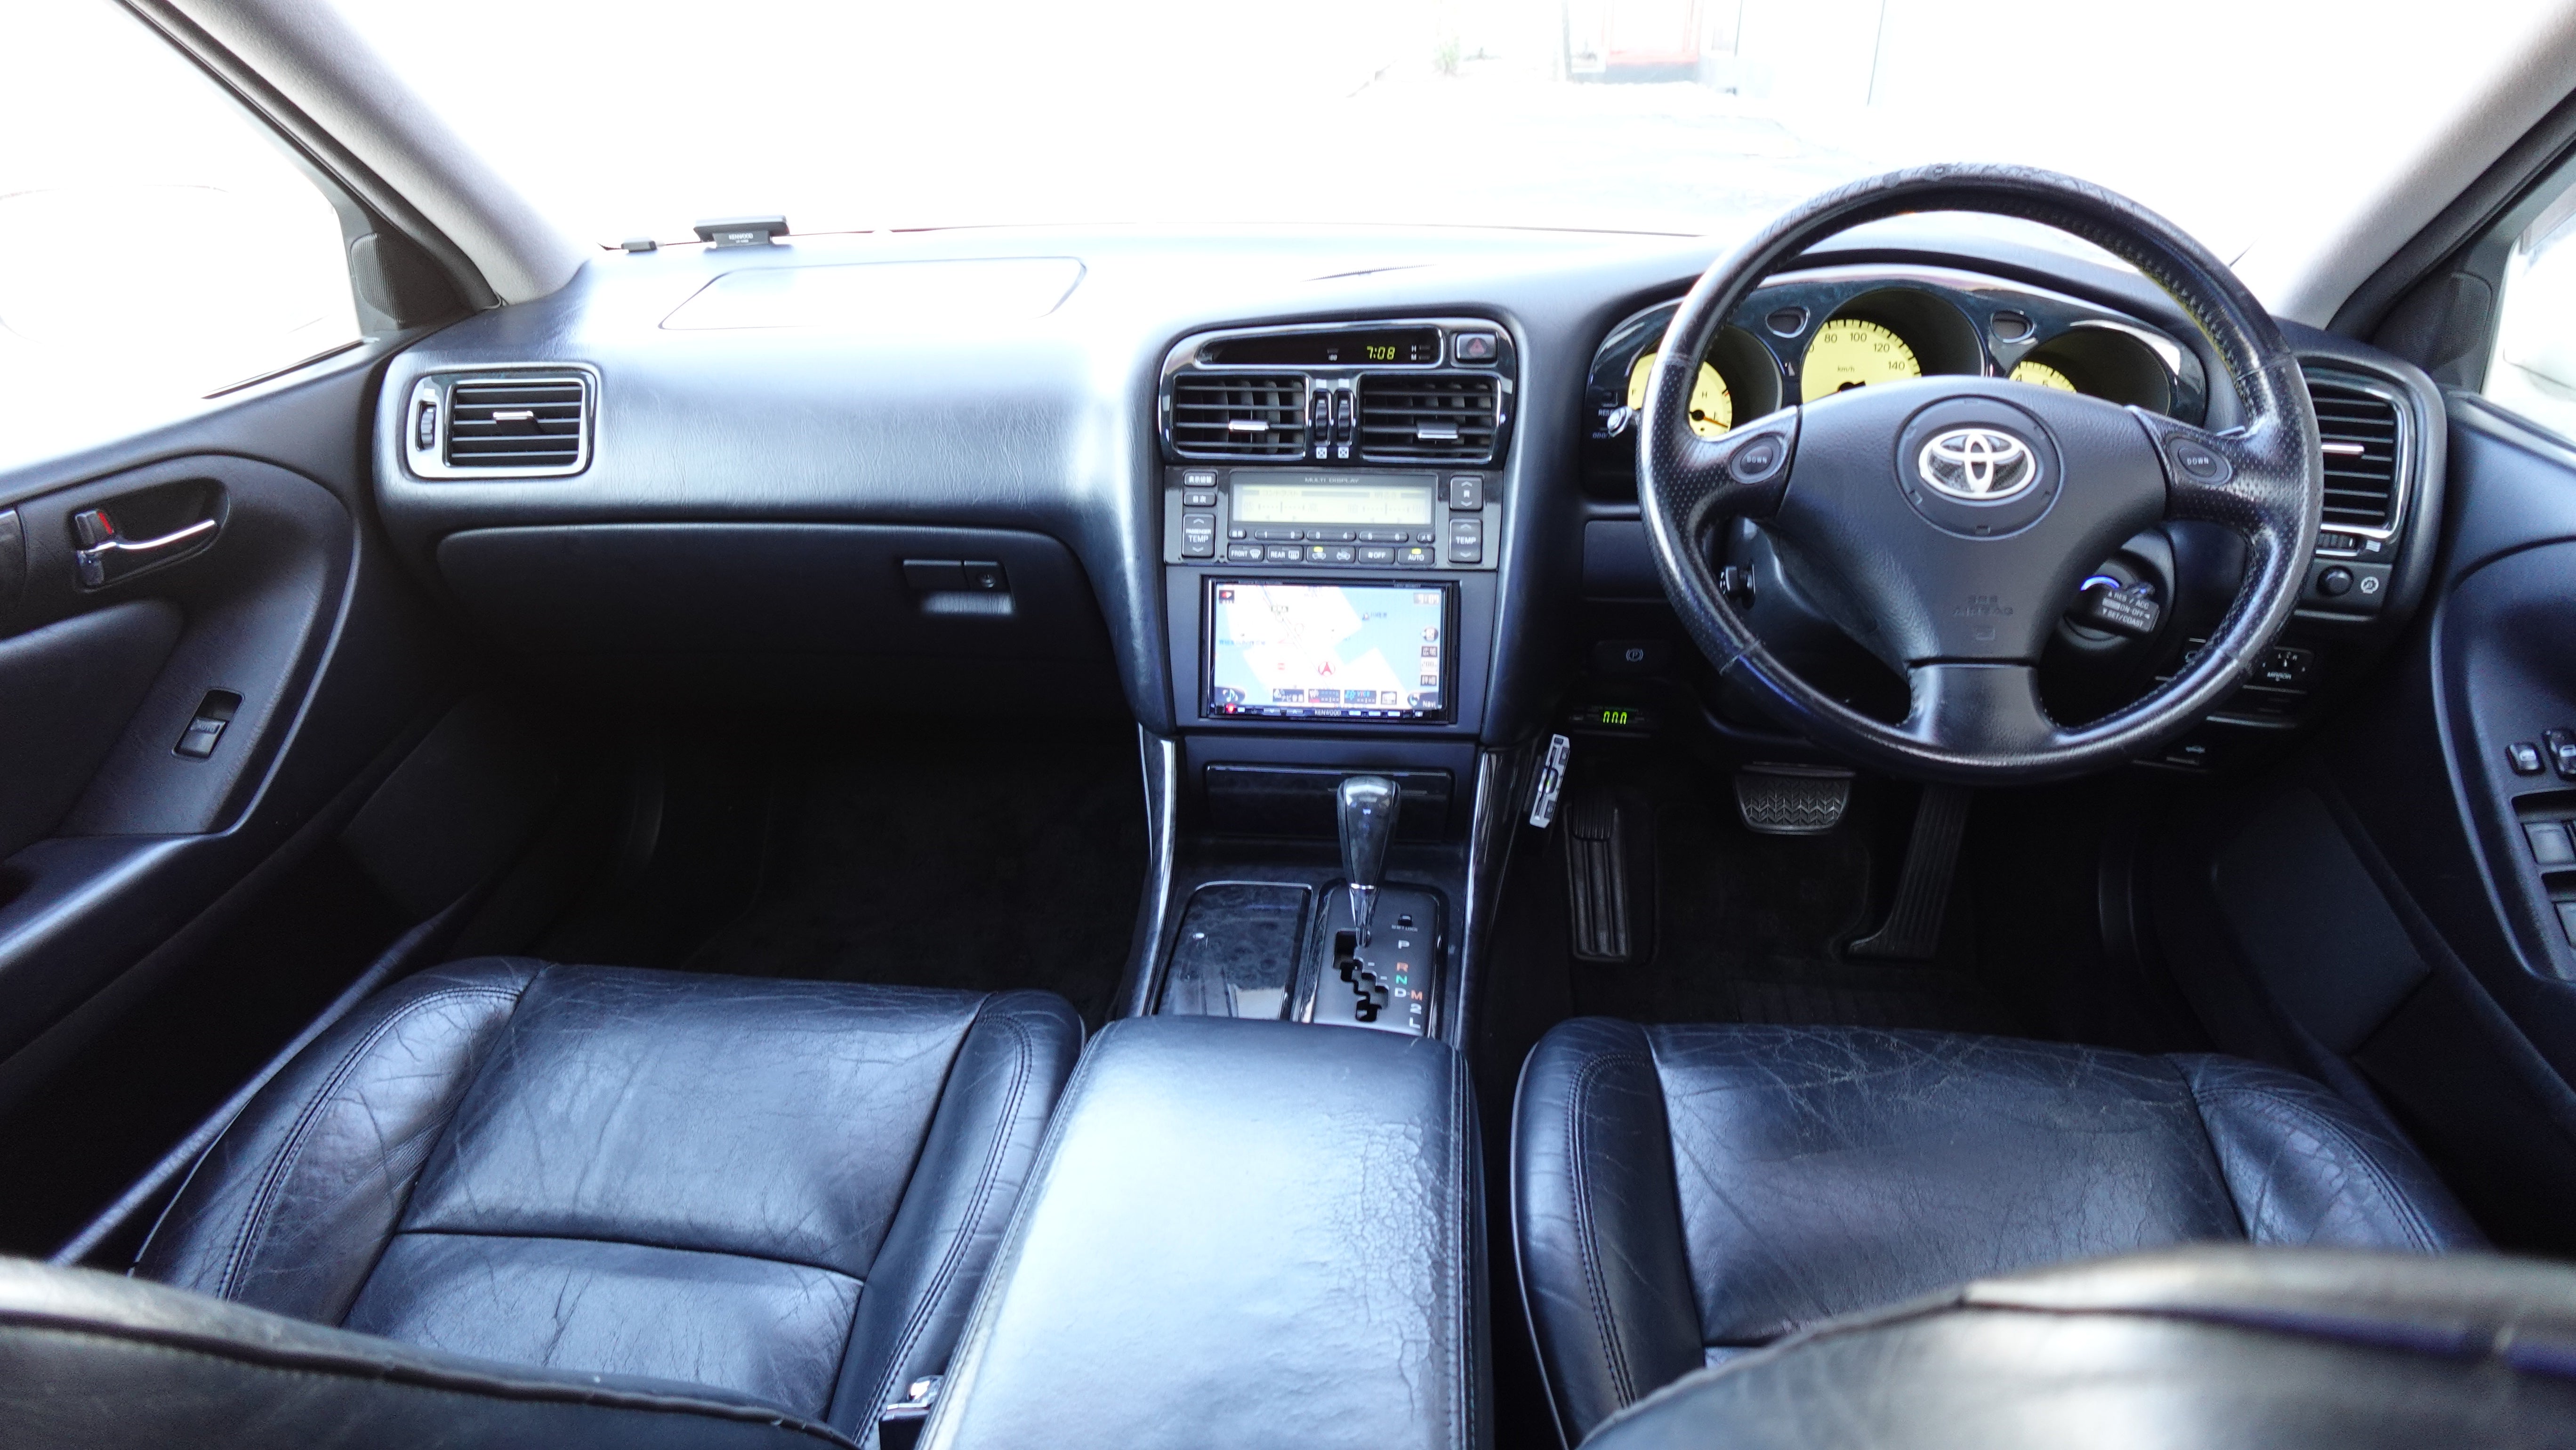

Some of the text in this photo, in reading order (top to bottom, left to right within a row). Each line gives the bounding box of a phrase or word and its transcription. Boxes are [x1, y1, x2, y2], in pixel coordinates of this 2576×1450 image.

[1824, 333, 1837, 343] 80
[1850, 332, 1867, 343] 100
[1367, 346, 1395, 360] 7:08
[1874, 343, 1890, 353] 120
[1888, 361, 1905, 371] 140
[1702, 391, 1707, 399] H
[1747, 455, 1768, 464] DOWN
[2187, 457, 2209, 466] DOWN
[1188, 535, 1208, 543] TEMP
[1290, 531, 1295, 539] 2
[1343, 532, 1347, 540] 4
[1456, 536, 1476, 545] TEMP
[1271, 550, 1285, 559] REAR
[1314, 709, 1342, 717] KENWOOD
[1398, 940, 1410, 949] P
[1396, 962, 1409, 972] R
[1396, 974, 1408, 985] N
[1394, 987, 1407, 998] D
[1411, 989, 1423, 1001] M
[1409, 1003, 1422, 1015] 2
[1409, 1016, 1421, 1030] L
